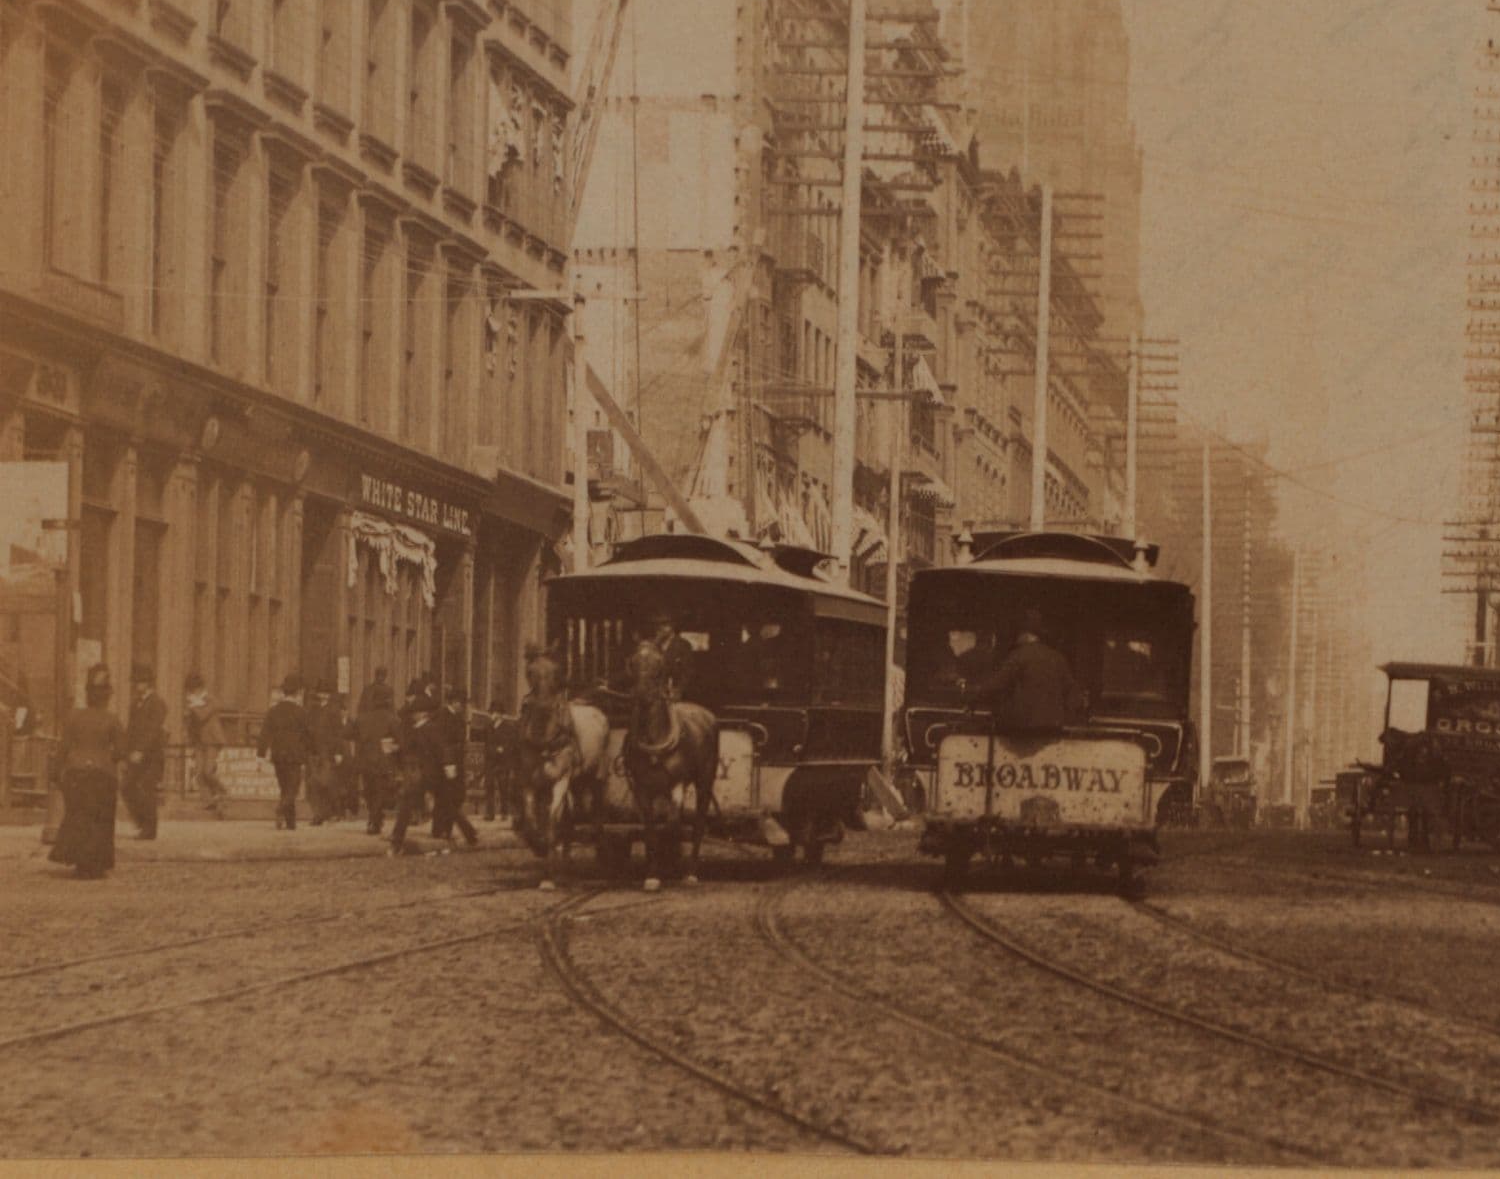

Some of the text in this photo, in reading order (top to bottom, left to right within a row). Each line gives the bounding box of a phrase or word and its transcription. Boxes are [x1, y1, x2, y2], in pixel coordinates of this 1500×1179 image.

[361, 474, 403, 513] WHITE
[406, 490, 439, 525] STAR
[953, 761, 1129, 793] BROADWAY
